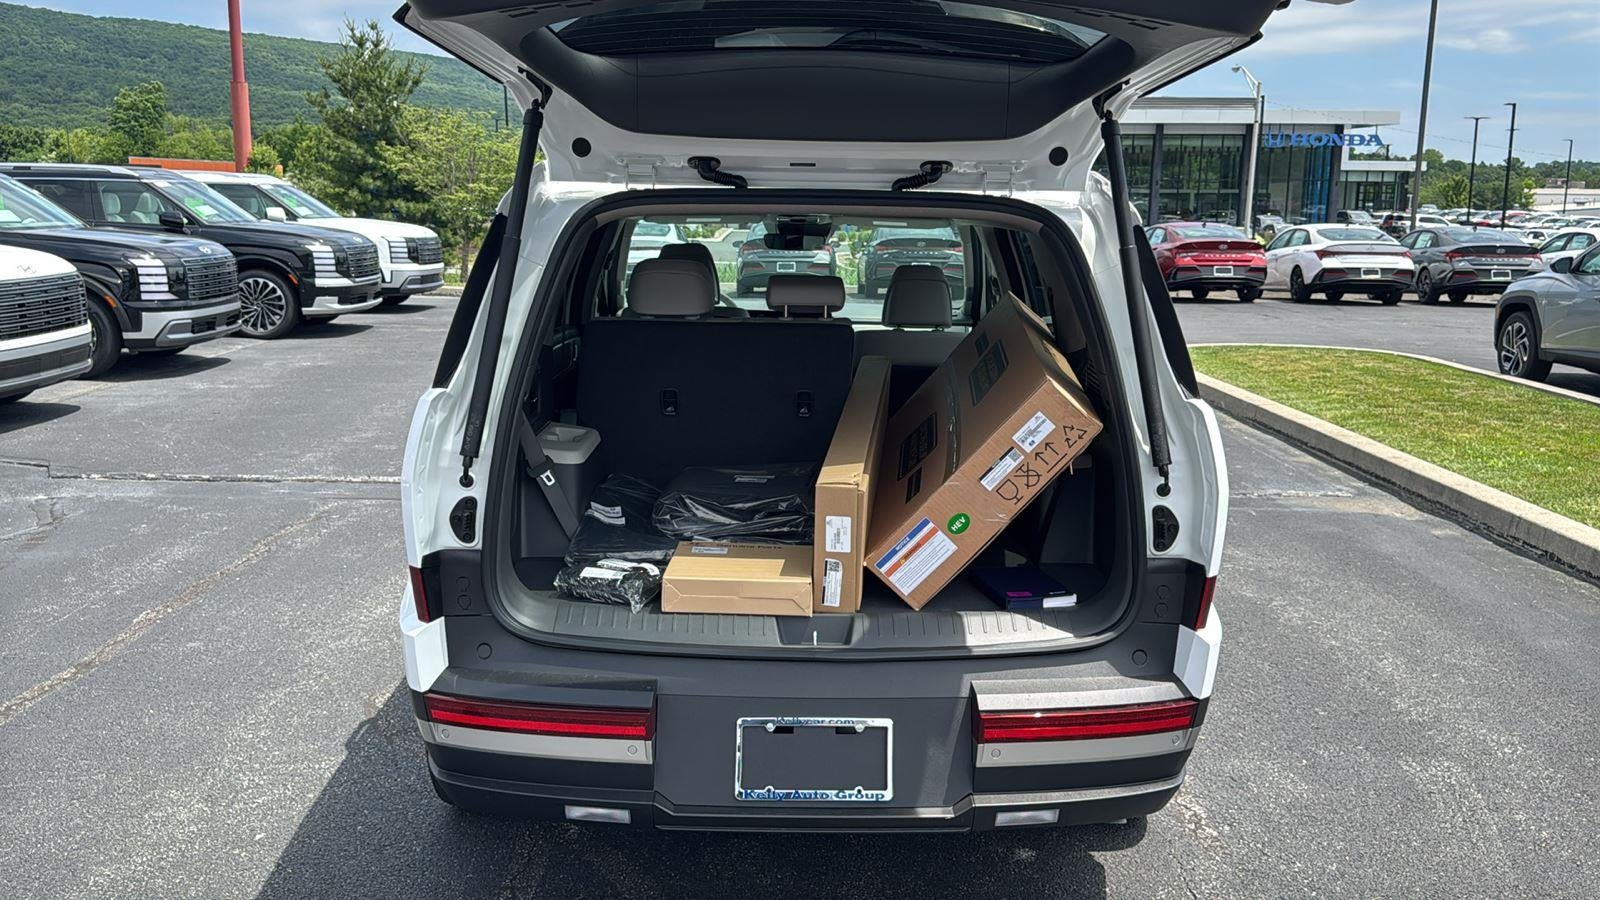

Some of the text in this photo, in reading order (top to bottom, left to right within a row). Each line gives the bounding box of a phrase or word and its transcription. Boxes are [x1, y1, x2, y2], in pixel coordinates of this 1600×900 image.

[1290, 133, 1384, 146] HONDA
[951, 516, 966, 532] HEV
[776, 717, 855, 726] Kellycar.com
[743, 790, 885, 801] Kelly Auto Group
